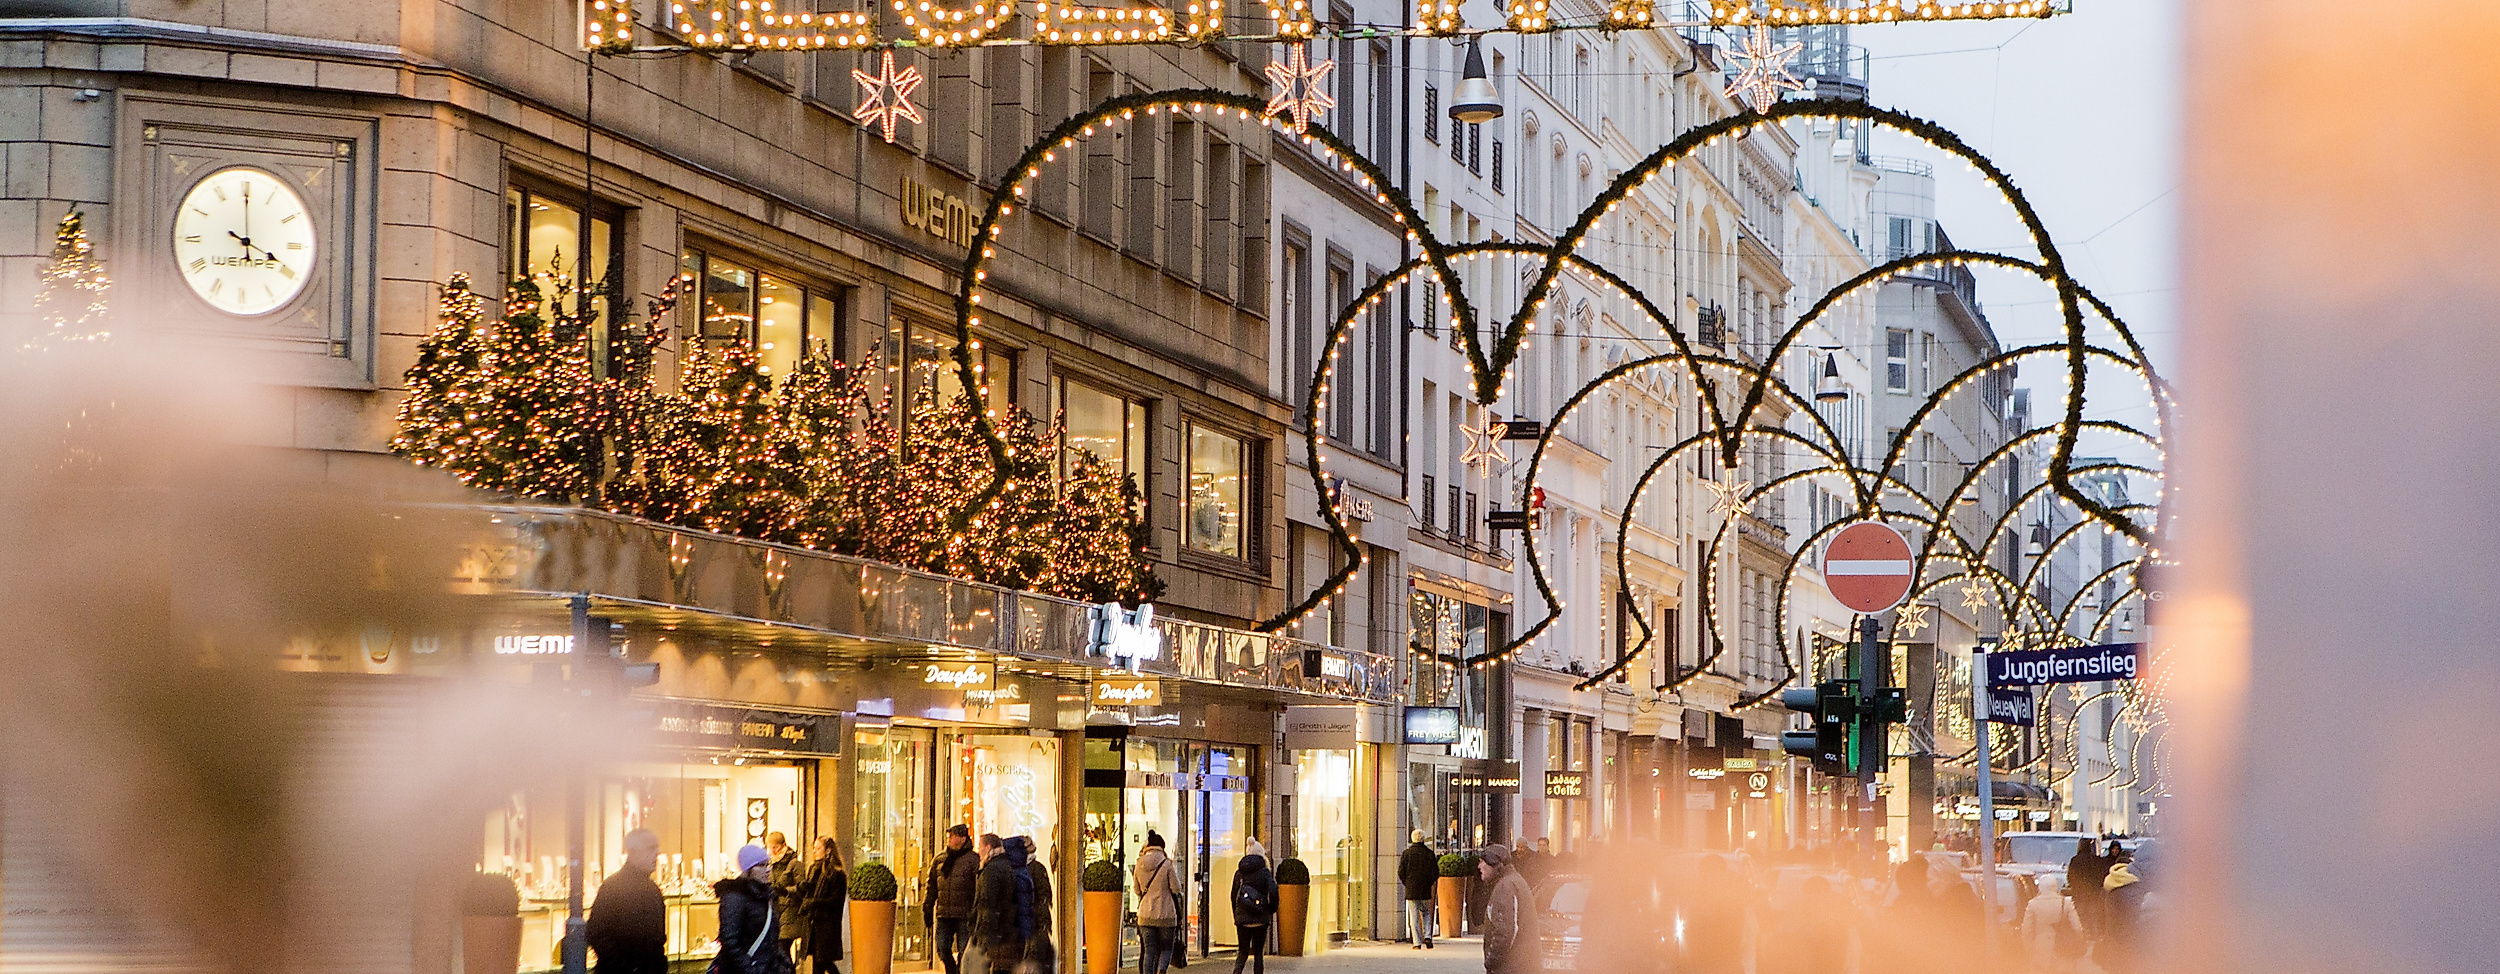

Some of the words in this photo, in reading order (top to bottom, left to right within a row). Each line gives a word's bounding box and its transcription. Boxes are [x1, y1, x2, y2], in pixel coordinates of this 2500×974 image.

[900, 176, 982, 250] WEMP
[211, 256, 276, 269] WEMPE
[494, 635, 576, 654] WEMP
[924, 665, 988, 688] Douglas
[1998, 650, 2137, 684] Jungfernstieg
[1098, 683, 1154, 704] Douglas
[1988, 692, 2012, 717] Neuer
[2011, 695, 2031, 721] Wall
[1407, 730, 1430, 739] FREY
[1432, 730, 1456, 739] WILLE
[1726, 761, 1753, 769] CALIDA
[1488, 778, 1519, 787] MANGO
